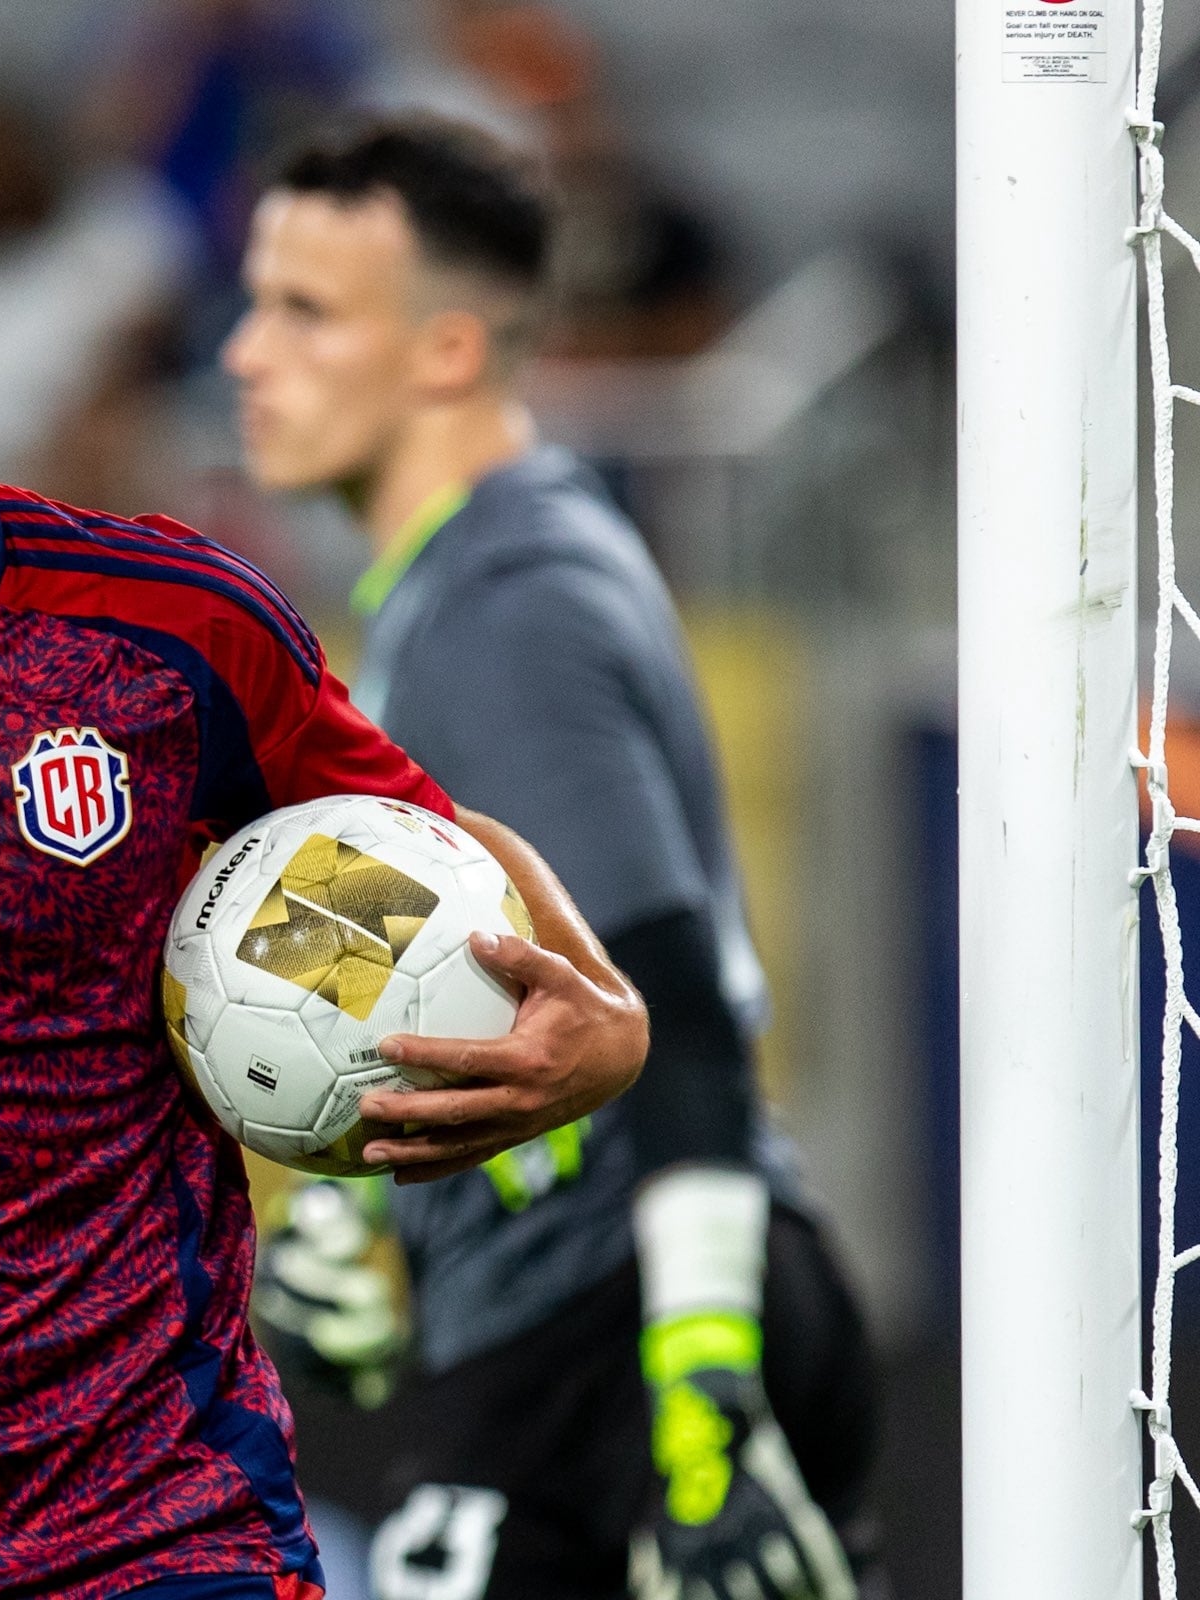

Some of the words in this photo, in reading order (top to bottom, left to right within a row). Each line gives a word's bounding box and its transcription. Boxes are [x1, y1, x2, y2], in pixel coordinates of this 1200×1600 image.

[1071, 22, 1098, 30] causing
[40, 755, 106, 839] CR
[196, 838, 261, 930] molten
[256, 1061, 273, 1074] FIFA
